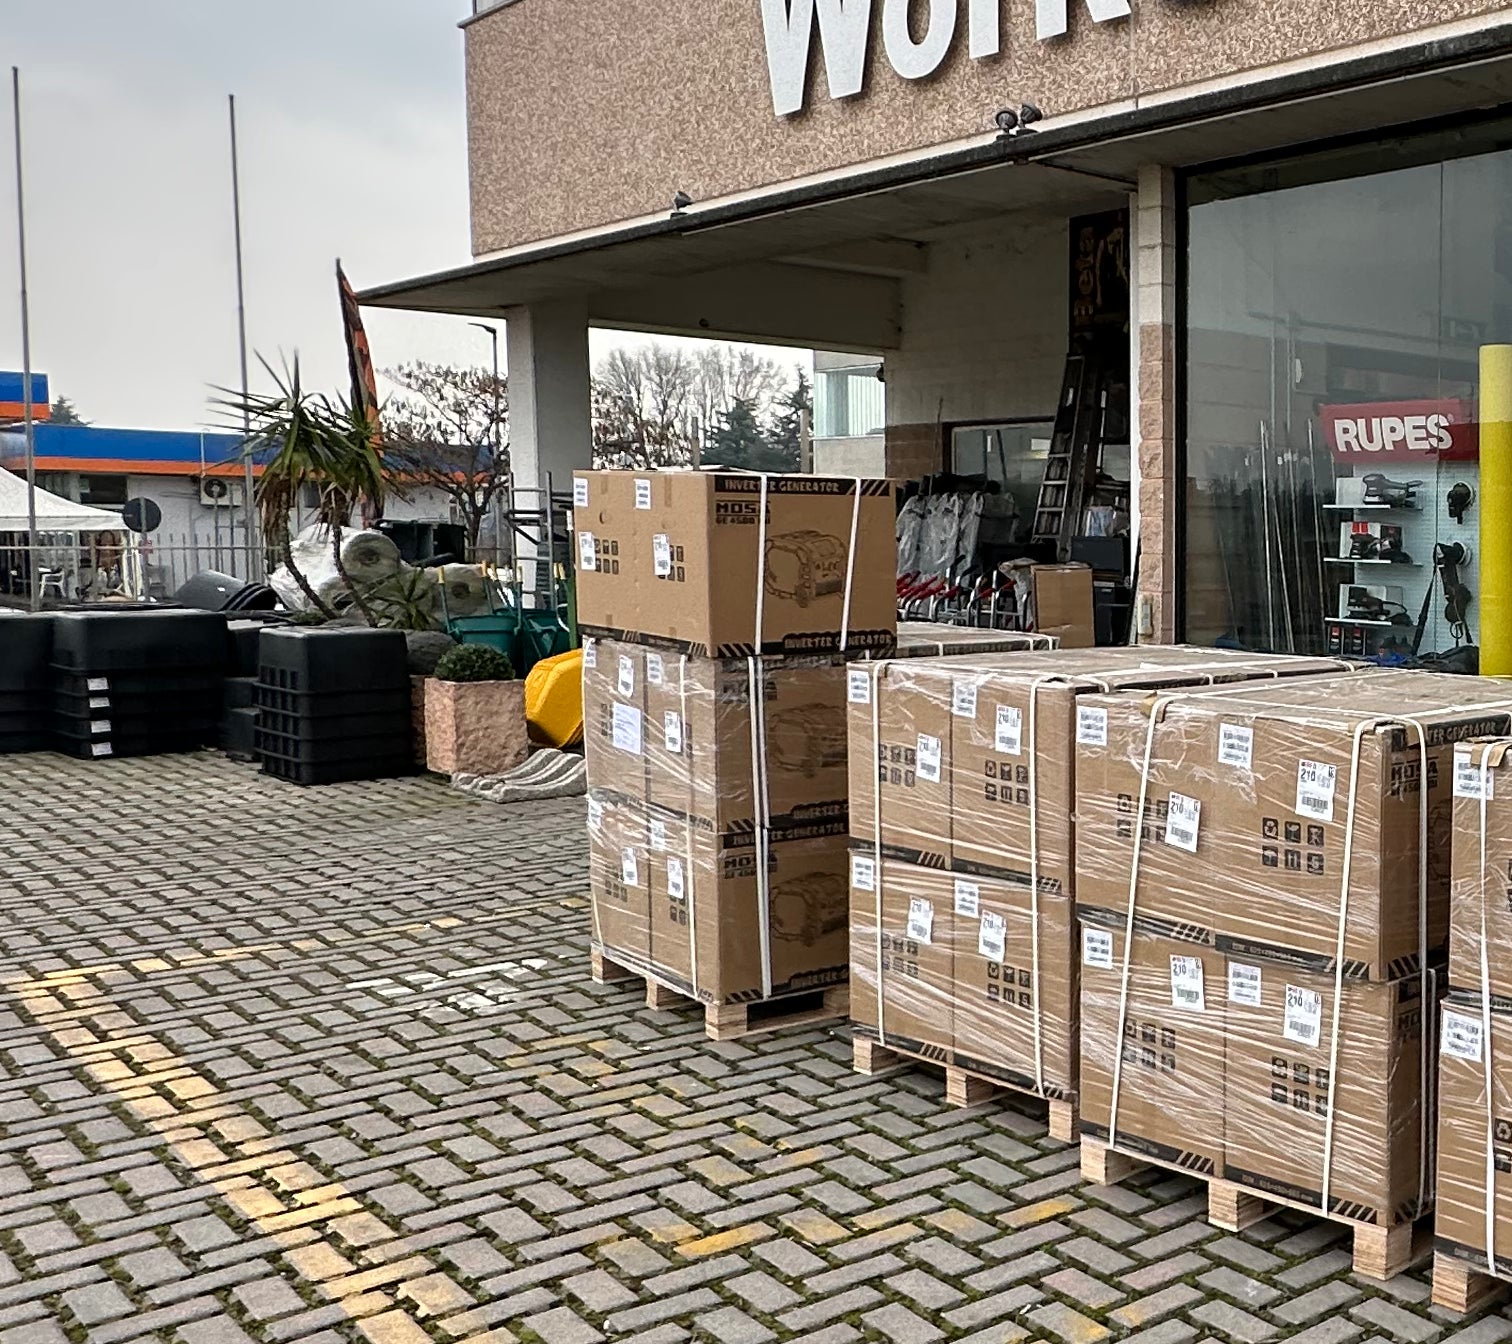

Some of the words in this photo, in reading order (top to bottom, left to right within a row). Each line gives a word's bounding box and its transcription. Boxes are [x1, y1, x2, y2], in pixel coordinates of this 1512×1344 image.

[1334, 413, 1453, 452] RUPES
[779, 481, 839, 492] GENERATOR
[1301, 770, 1316, 782] 210
[1288, 994, 1303, 1007] 210
